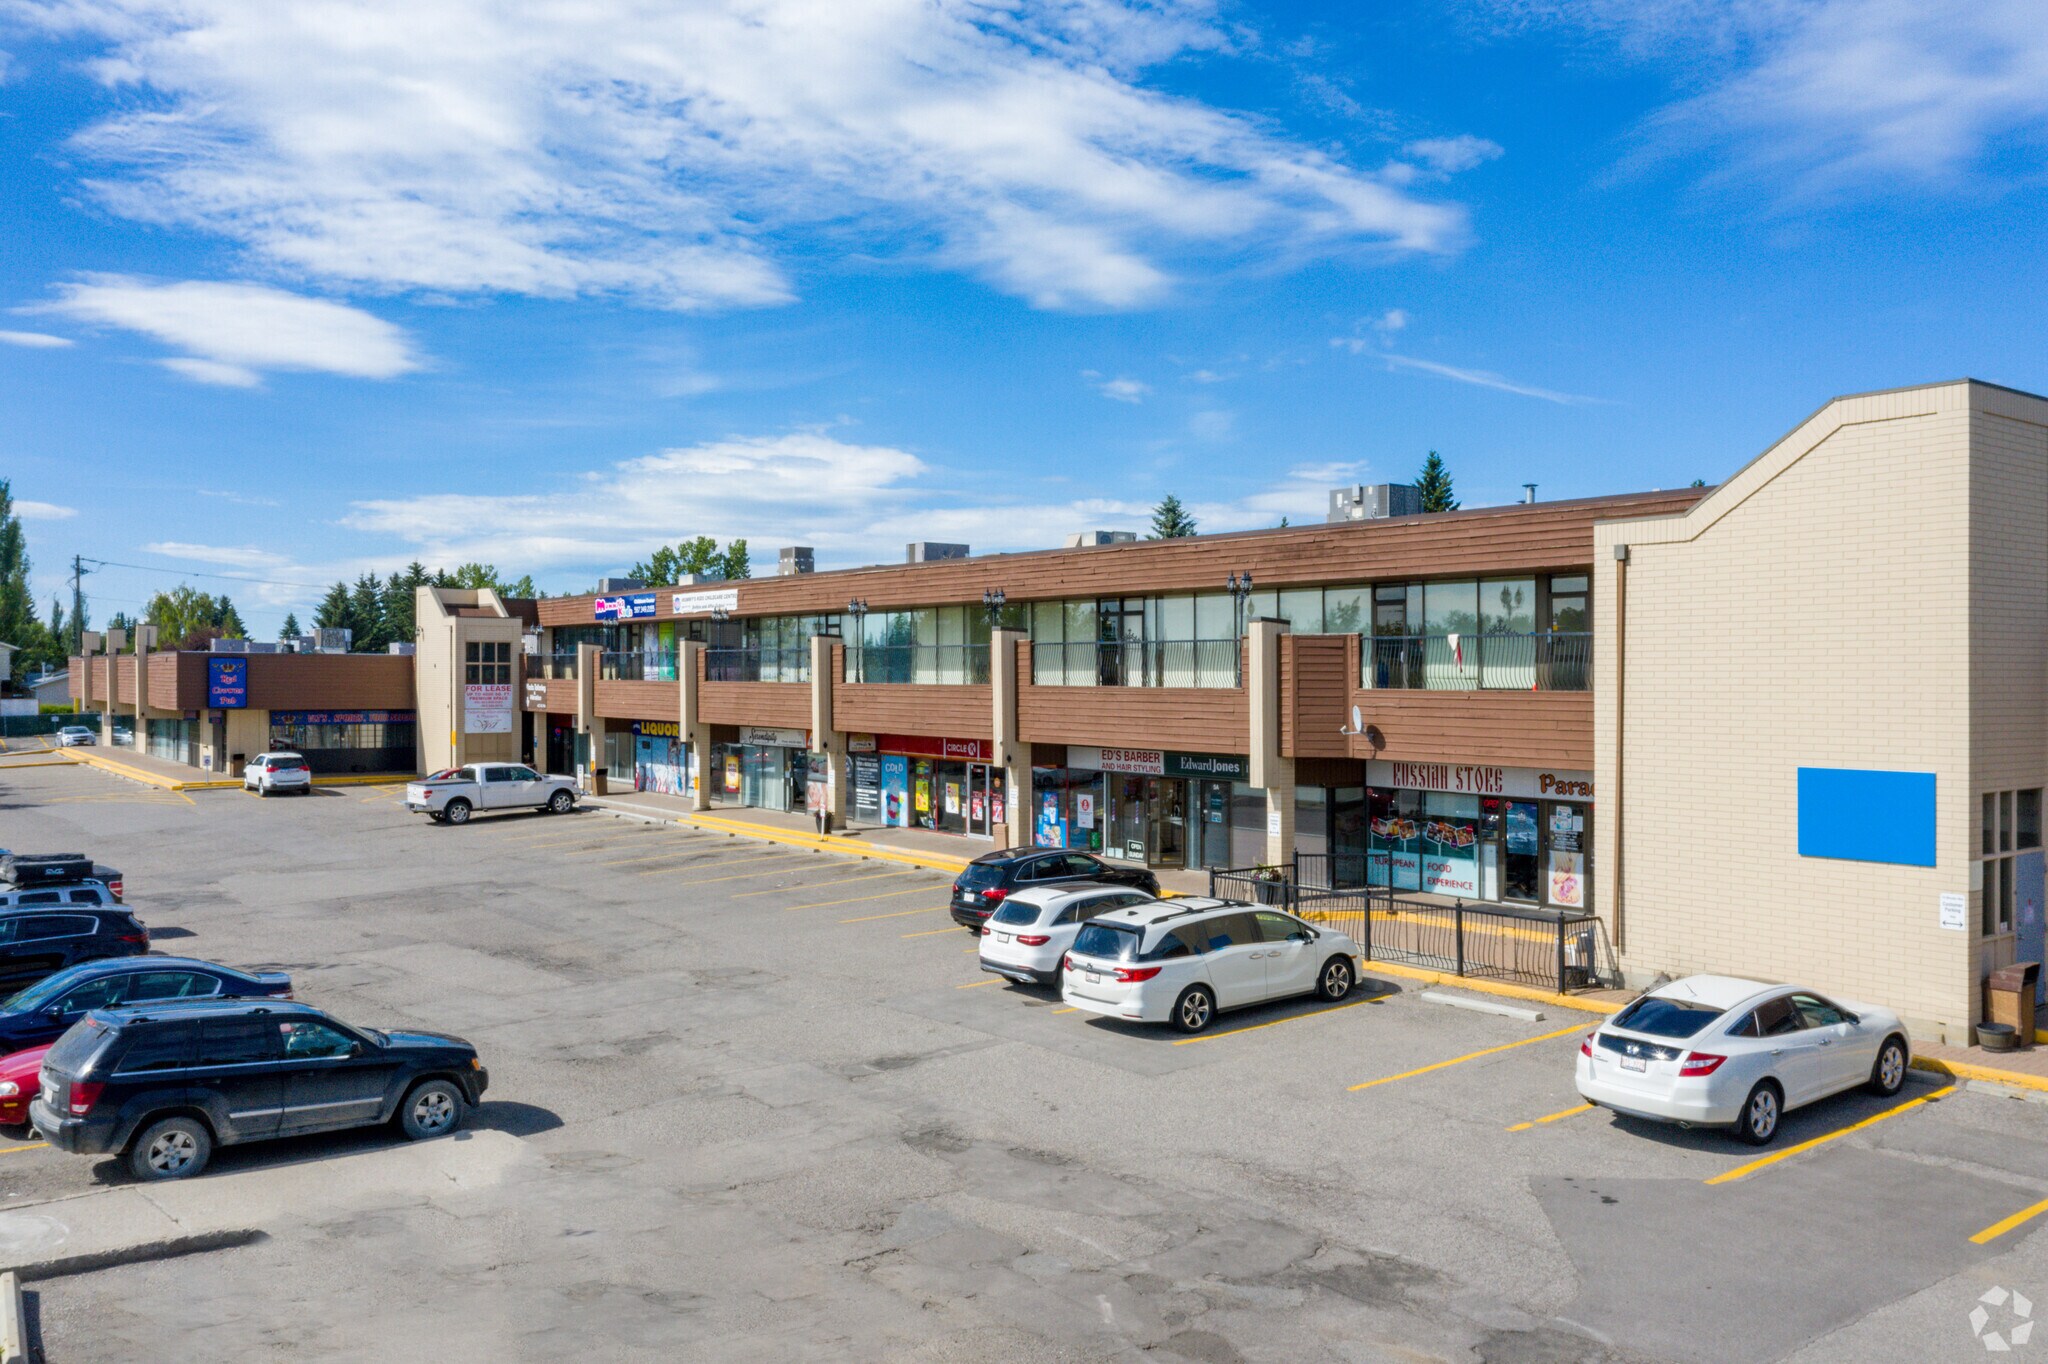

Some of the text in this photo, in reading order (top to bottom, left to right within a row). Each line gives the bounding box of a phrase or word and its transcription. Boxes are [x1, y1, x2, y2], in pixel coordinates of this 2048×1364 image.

[220, 674, 237, 684] Red
[220, 696, 237, 704] Pub
[641, 721, 680, 737] LIQUOR
[749, 727, 777, 744] Serendipity
[946, 742, 976, 756] CIRCLE K
[1101, 749, 1160, 763] ED'S BARBER
[885, 763, 904, 774] COLD
[1101, 762, 1161, 773] AND HAIR STYLING
[1393, 762, 1503, 793] RUSSIAN STORE
[1539, 773, 1594, 797] Para
[1130, 842, 1142, 850] OPEN
[1128, 851, 1144, 859] SUNDAY
[1427, 862, 1452, 873] FOOD
[1427, 876, 1473, 890] EXPERIENCE
